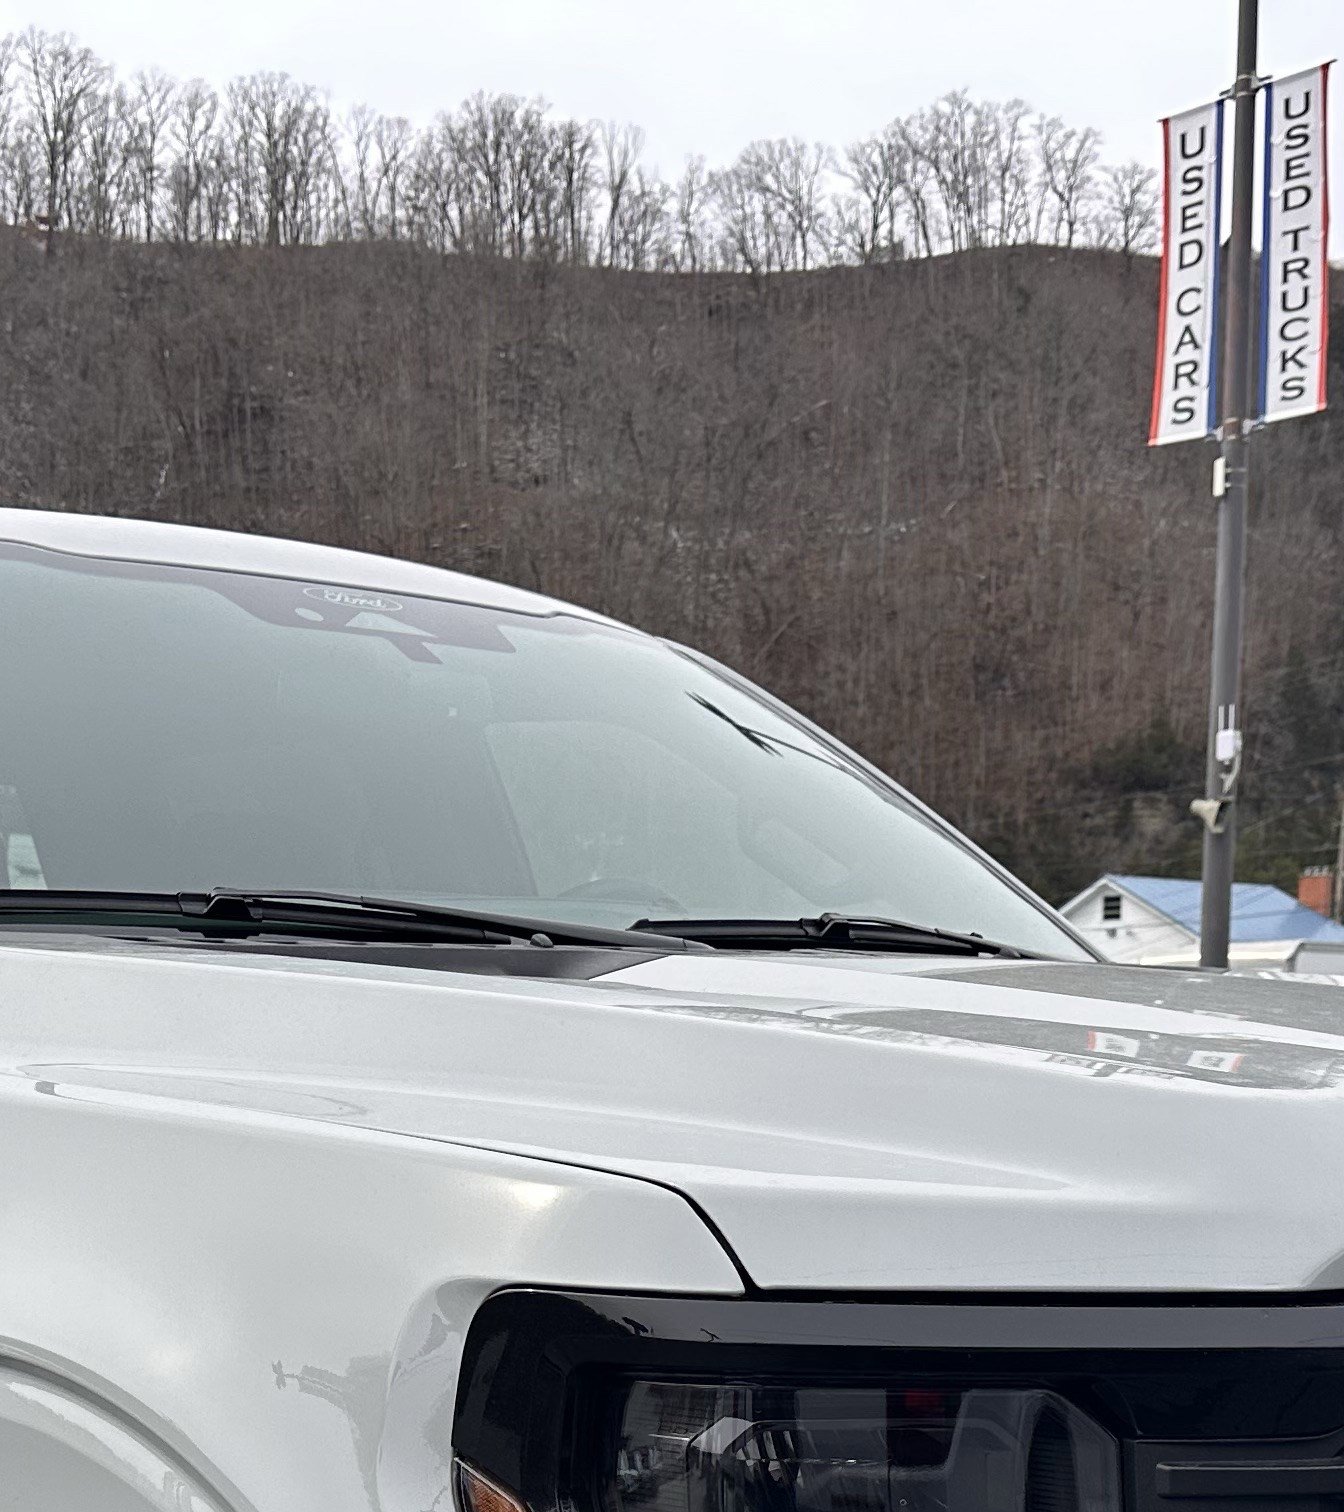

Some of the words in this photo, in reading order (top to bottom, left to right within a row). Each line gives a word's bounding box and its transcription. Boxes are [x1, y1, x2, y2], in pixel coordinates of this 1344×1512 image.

[1177, 125, 1207, 270] USED
[1280, 90, 1312, 213] USED
[1171, 286, 1203, 425] CARS
[1279, 225, 1311, 401] TRUCKS
